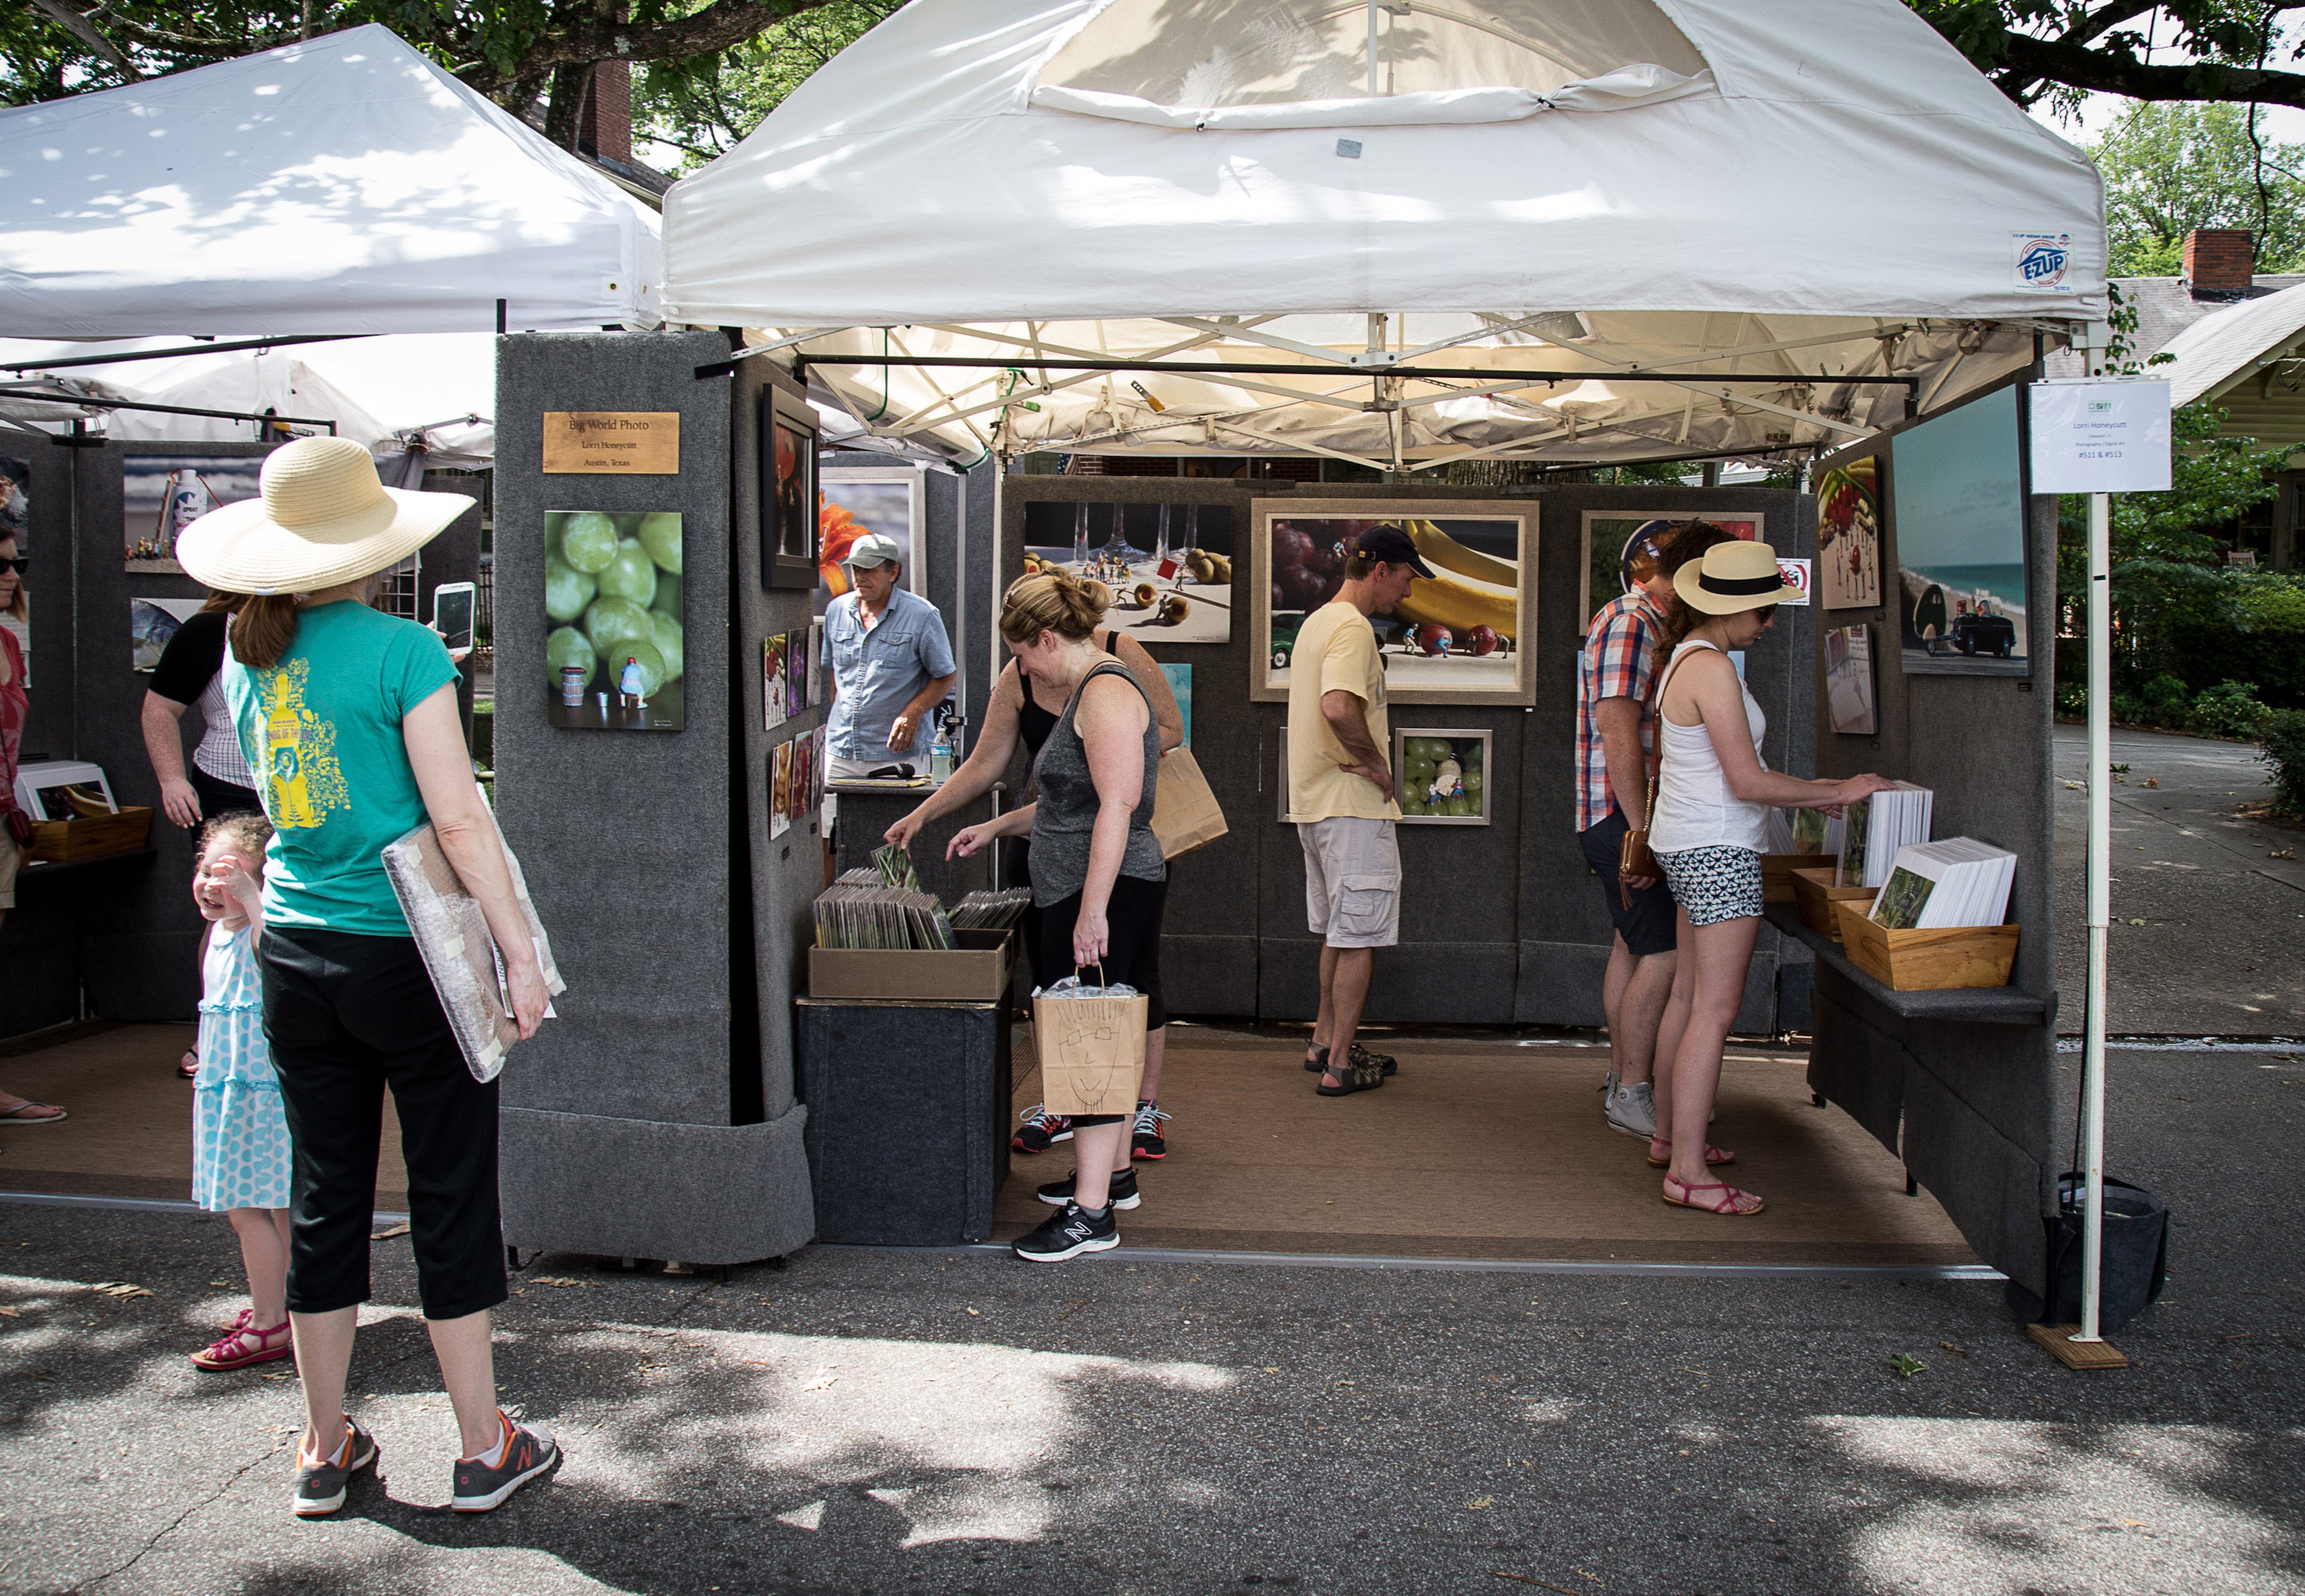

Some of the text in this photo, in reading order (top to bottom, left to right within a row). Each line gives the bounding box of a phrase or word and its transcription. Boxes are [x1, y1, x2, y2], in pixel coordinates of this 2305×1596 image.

[569, 420, 649, 432] Big World Photo
[601, 441, 637, 450] Honeycutt
